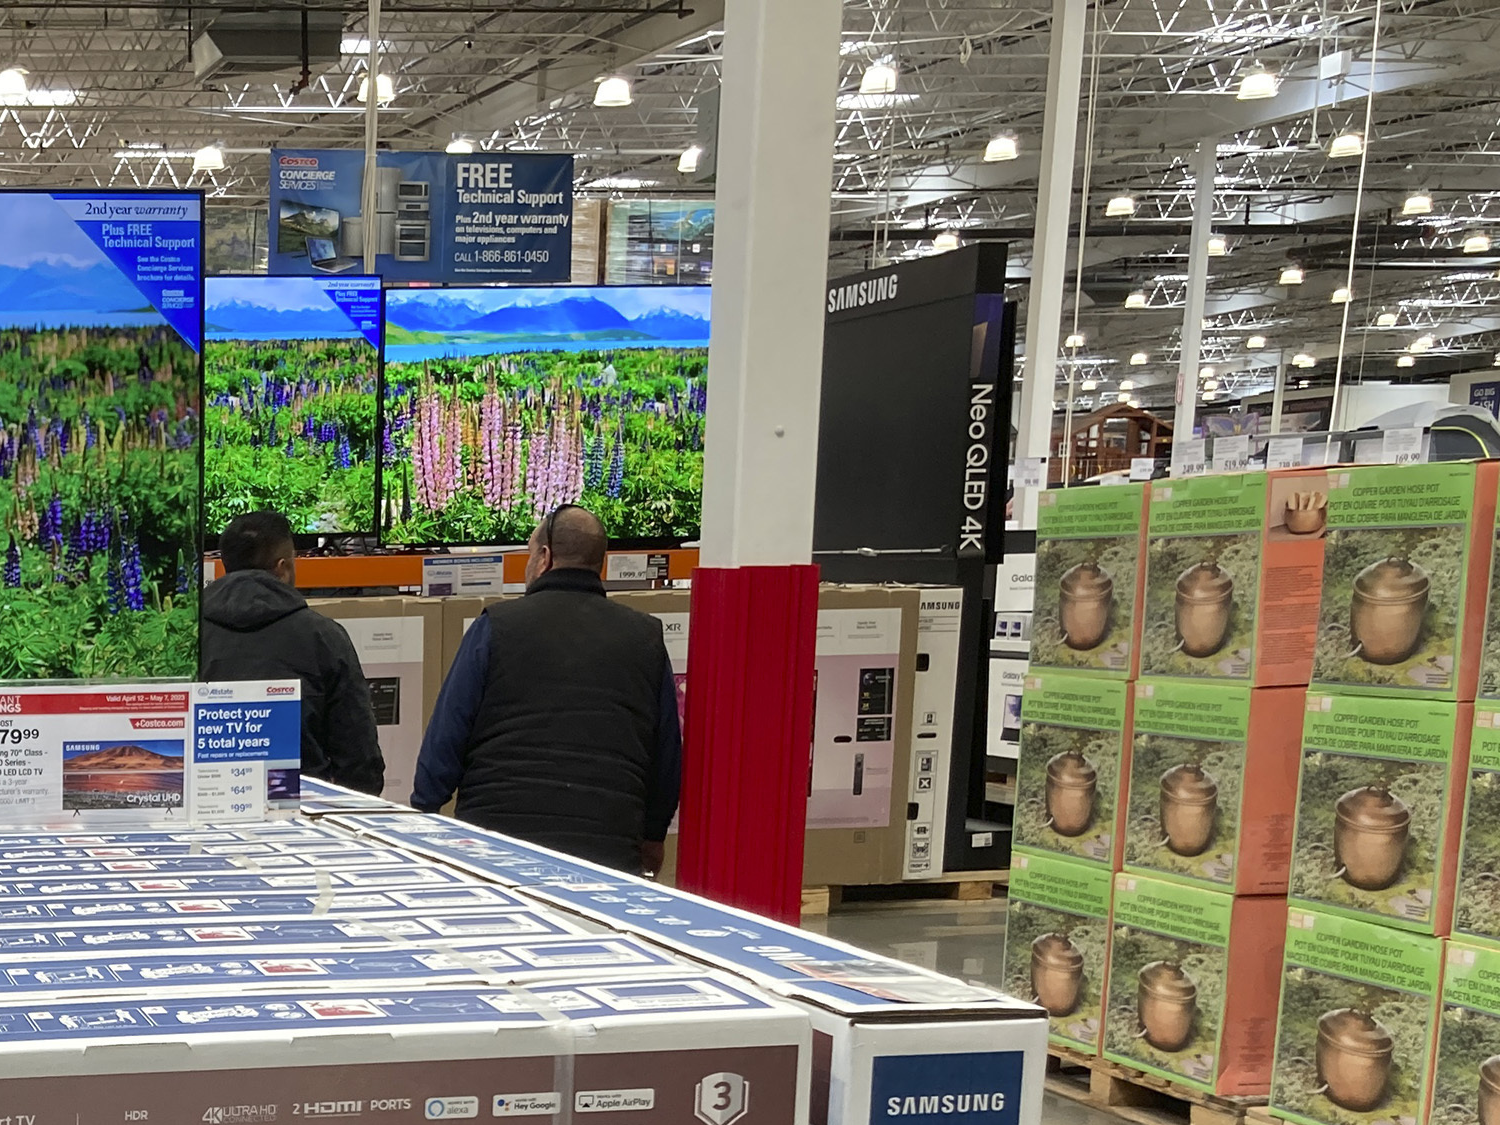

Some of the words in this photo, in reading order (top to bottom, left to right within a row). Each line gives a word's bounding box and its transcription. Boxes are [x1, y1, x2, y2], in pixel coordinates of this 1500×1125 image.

[280, 171, 335, 180] CONCIERGE
[457, 163, 512, 188] FREE
[279, 180, 316, 190] SERVICES
[457, 189, 514, 203] Technical
[517, 190, 563, 207] Support
[85, 203, 106, 215] 2nd
[110, 206, 132, 218] year
[135, 206, 188, 219] warranty
[456, 215, 471, 223] Plus
[473, 212, 492, 223] 2nd
[495, 215, 518, 226] year
[521, 214, 568, 227] warranty
[102, 224, 124, 235] Plus
[127, 224, 152, 235] FREE
[466, 225, 505, 234] televisions,
[506, 226, 542, 235] computers
[544, 226, 557, 234] and
[103, 236, 152, 247] Technical
[155, 238, 195, 250] Support
[455, 235, 475, 244] major
[477, 235, 515, 245] appliances
[455, 253, 471, 261] CALL
[475, 250, 549, 262] 1-866-861-0450
[828, 274, 898, 312] SAMSUNG
[968, 384, 993, 439] Neo
[1183, 464, 1204, 474] 249.99
[1225, 460, 1247, 470] 519.99
[964, 444, 987, 510] QLED
[960, 515, 982, 550] 4K
[123, 695, 136, 704] April
[198, 708, 242, 721] Protect
[245, 708, 271, 720] your
[198, 724, 222, 735] new
[226, 722, 243, 733] TV
[245, 722, 263, 733] for
[198, 738, 205, 749] 5
[209, 737, 235, 748] total
[238, 738, 270, 750] years
[127, 794, 161, 805] Crystal
[162, 793, 181, 802] UHD
[370, 1099, 412, 1111] PORTS
[447, 1106, 469, 1115] alexa
[887, 1093, 1005, 1116] SAMSUNG
[125, 1110, 148, 1121] HDR
